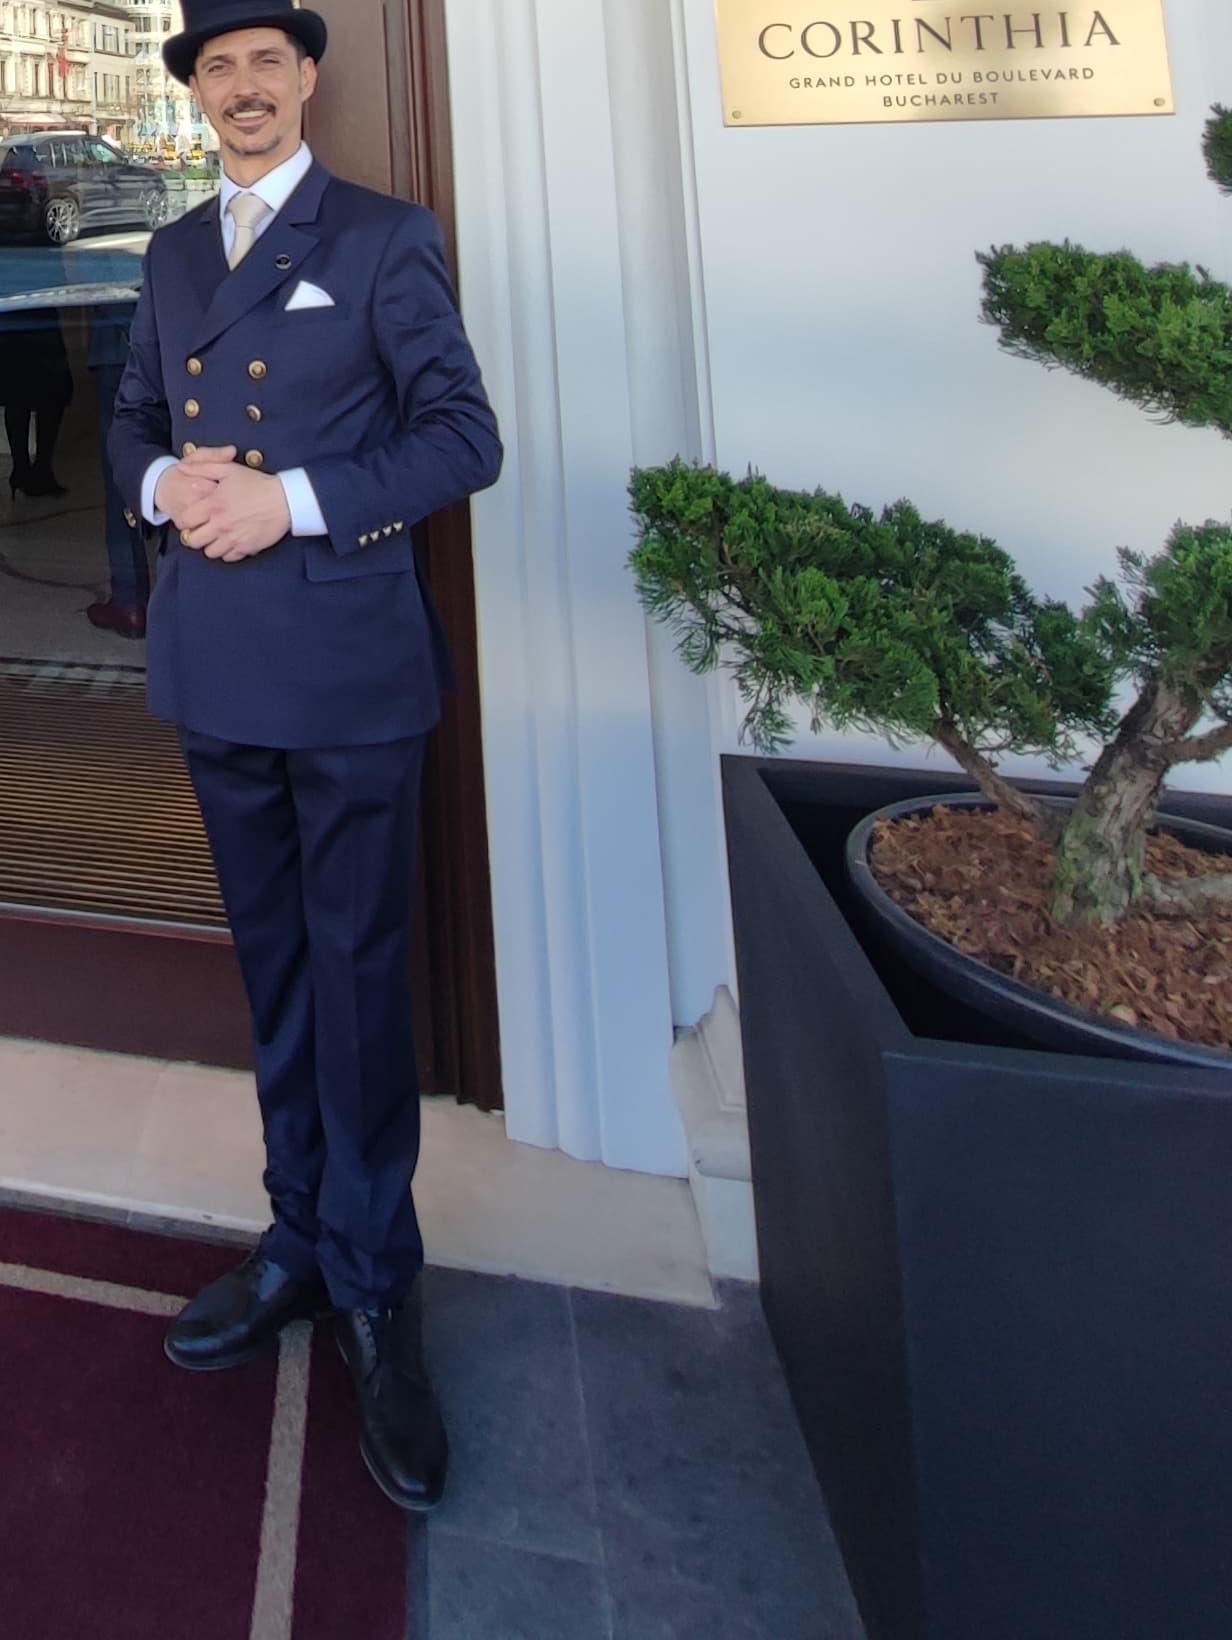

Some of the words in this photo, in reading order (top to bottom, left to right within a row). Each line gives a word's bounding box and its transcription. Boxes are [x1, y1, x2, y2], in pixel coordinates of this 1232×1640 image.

[758, 10, 1120, 60] CORINTHIA
[789, 75, 855, 89] GRAND
[865, 73, 928, 87] HOTEL
[936, 72, 963, 85] DU
[973, 67, 1095, 83] BOULEVARD
[882, 92, 999, 108] BUCHAREST
